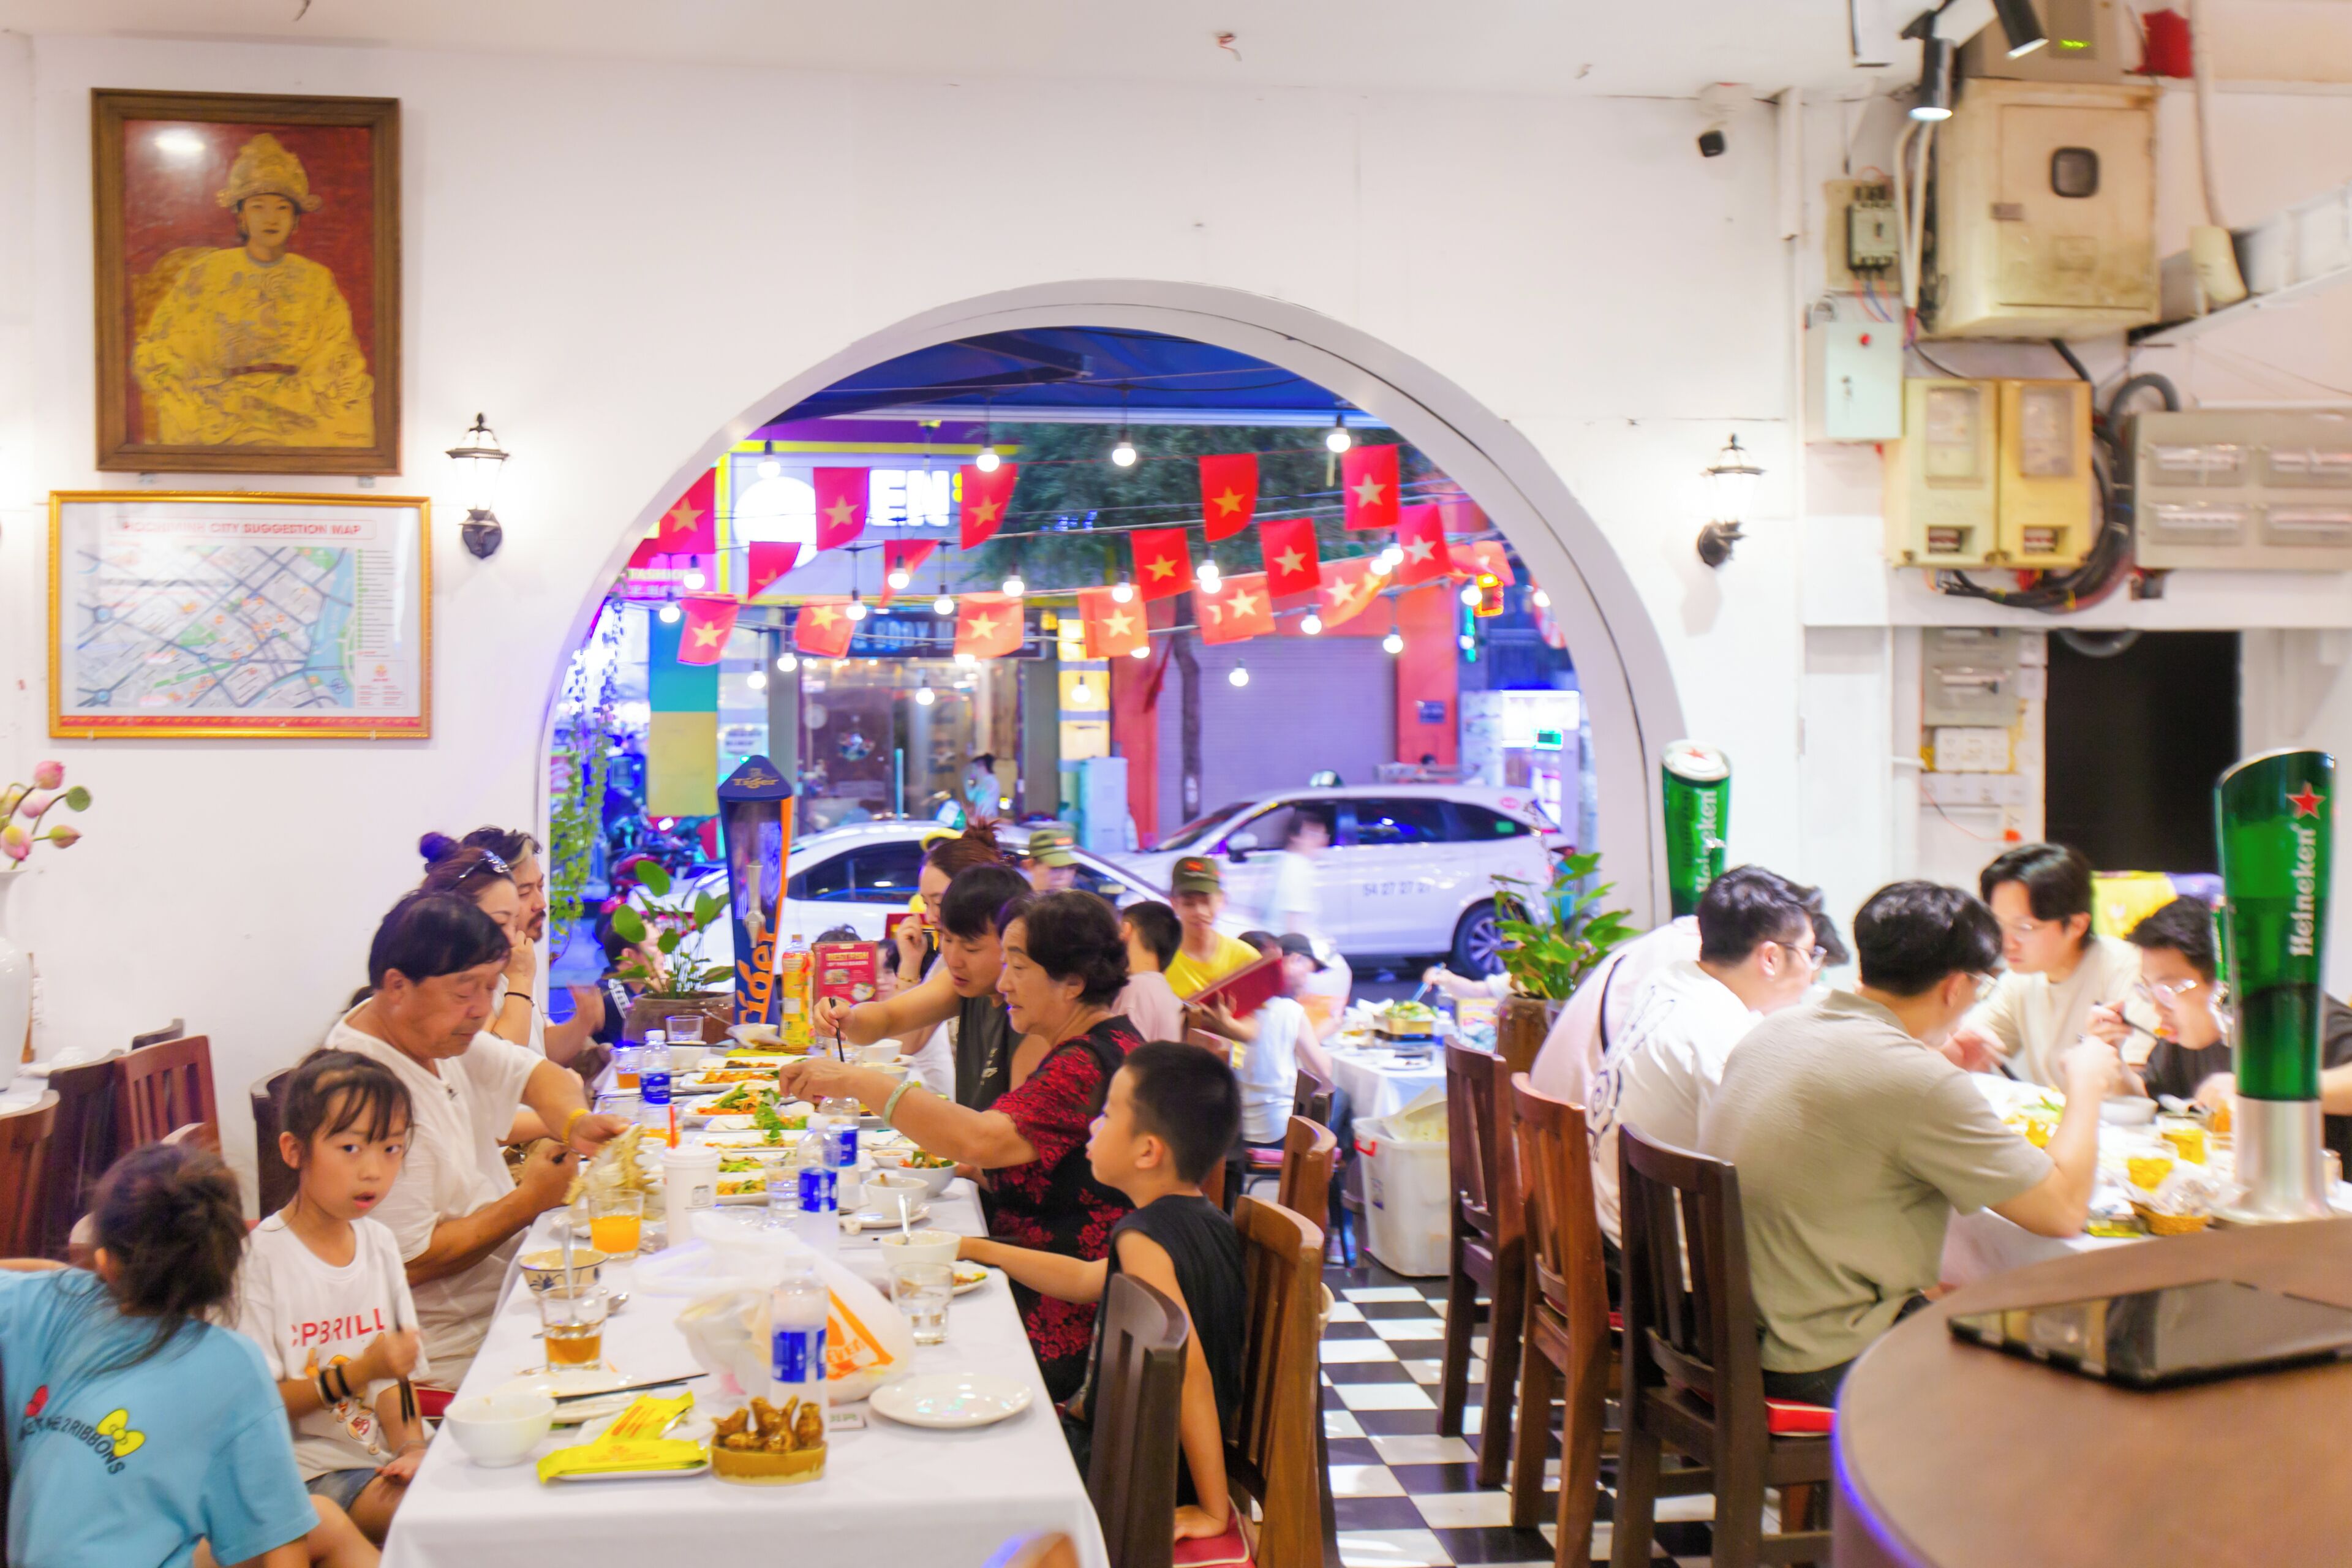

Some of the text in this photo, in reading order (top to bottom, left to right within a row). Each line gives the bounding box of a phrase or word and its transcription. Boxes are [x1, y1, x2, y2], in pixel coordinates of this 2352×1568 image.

[865, 469, 949, 527] EN
[210, 524, 239, 533] CITY
[243, 524, 327, 535] SUGGESTION
[332, 525, 362, 535] MAP
[732, 777, 779, 789] Tiger
[2288, 822, 2317, 957] Heineken
[736, 926, 775, 1024] iger
[61, 1417, 72, 1432] 2
[69, 1419, 125, 1475] RIBBONS
